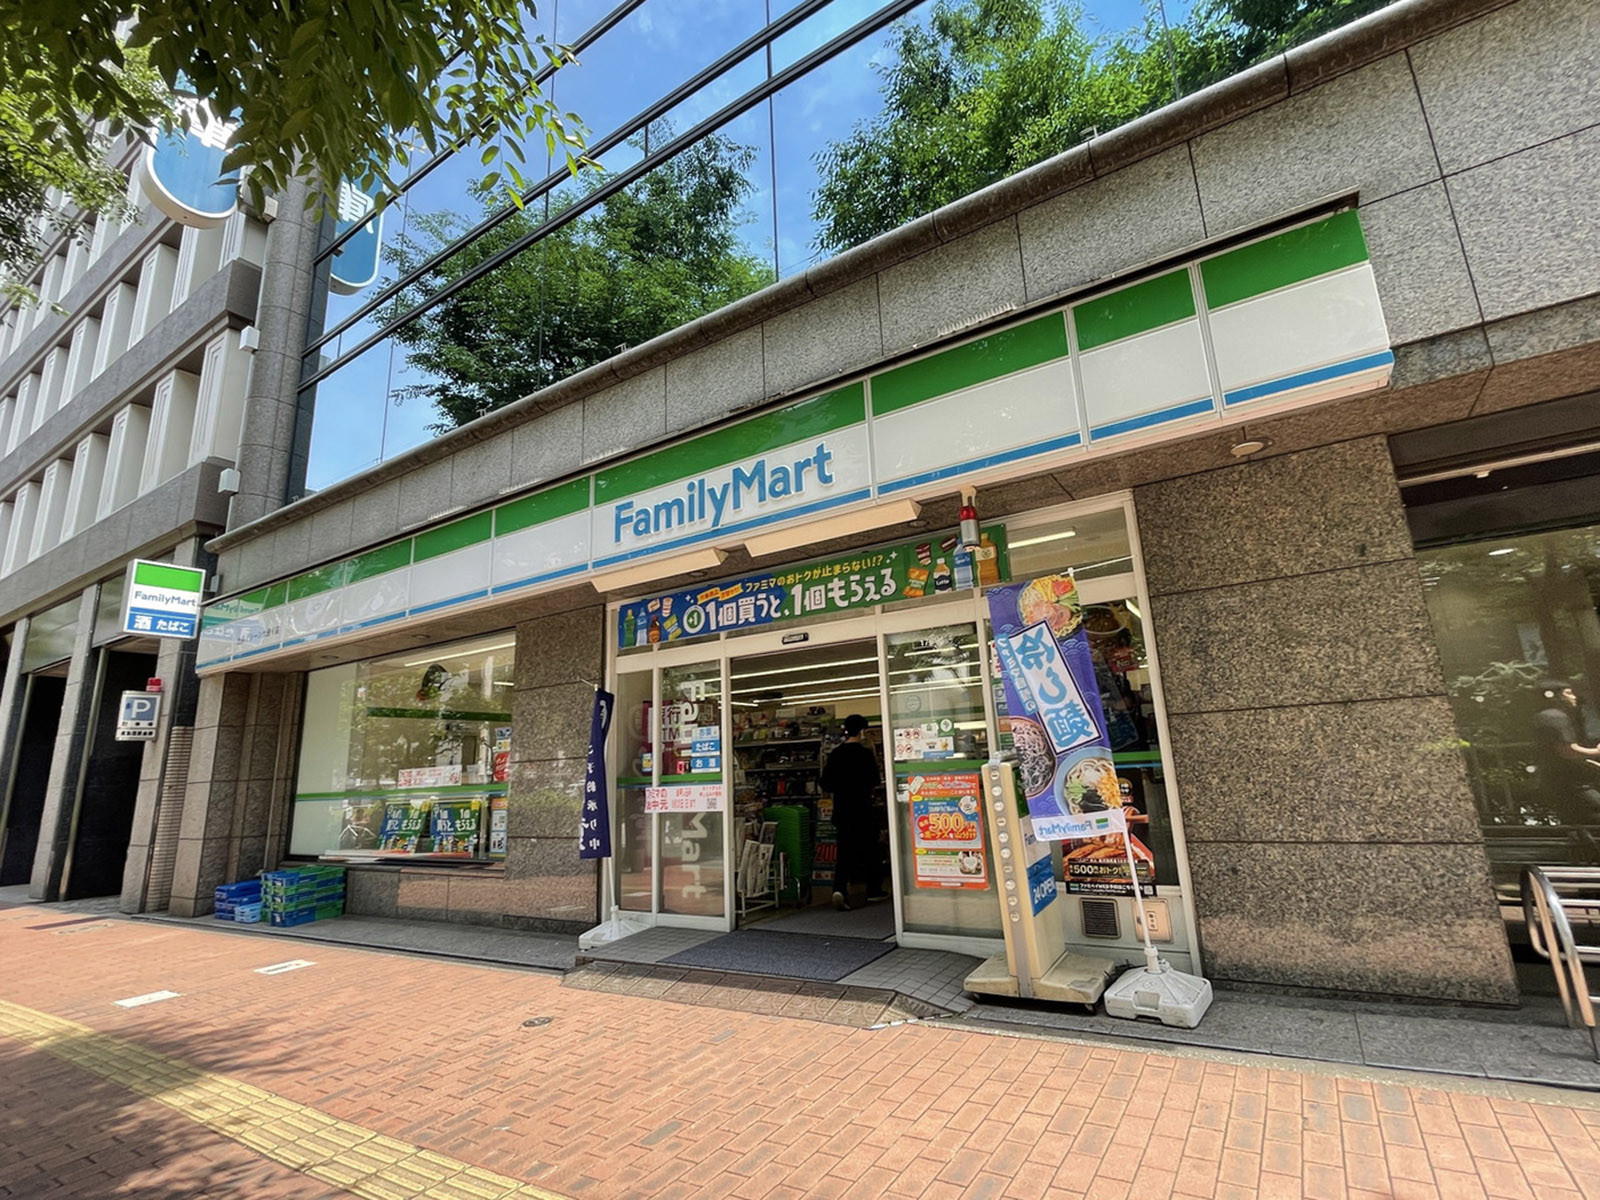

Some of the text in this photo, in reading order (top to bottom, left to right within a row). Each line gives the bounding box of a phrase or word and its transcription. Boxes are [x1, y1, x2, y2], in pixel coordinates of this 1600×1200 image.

[614, 443, 833, 543] FamilyMart
[134, 590, 196, 607] FamilyMart
[133, 615, 190, 633] 酒 たばこ
[131, 699, 151, 718] P
[696, 742, 715, 752] たばこ
[929, 813, 965, 832] 500
